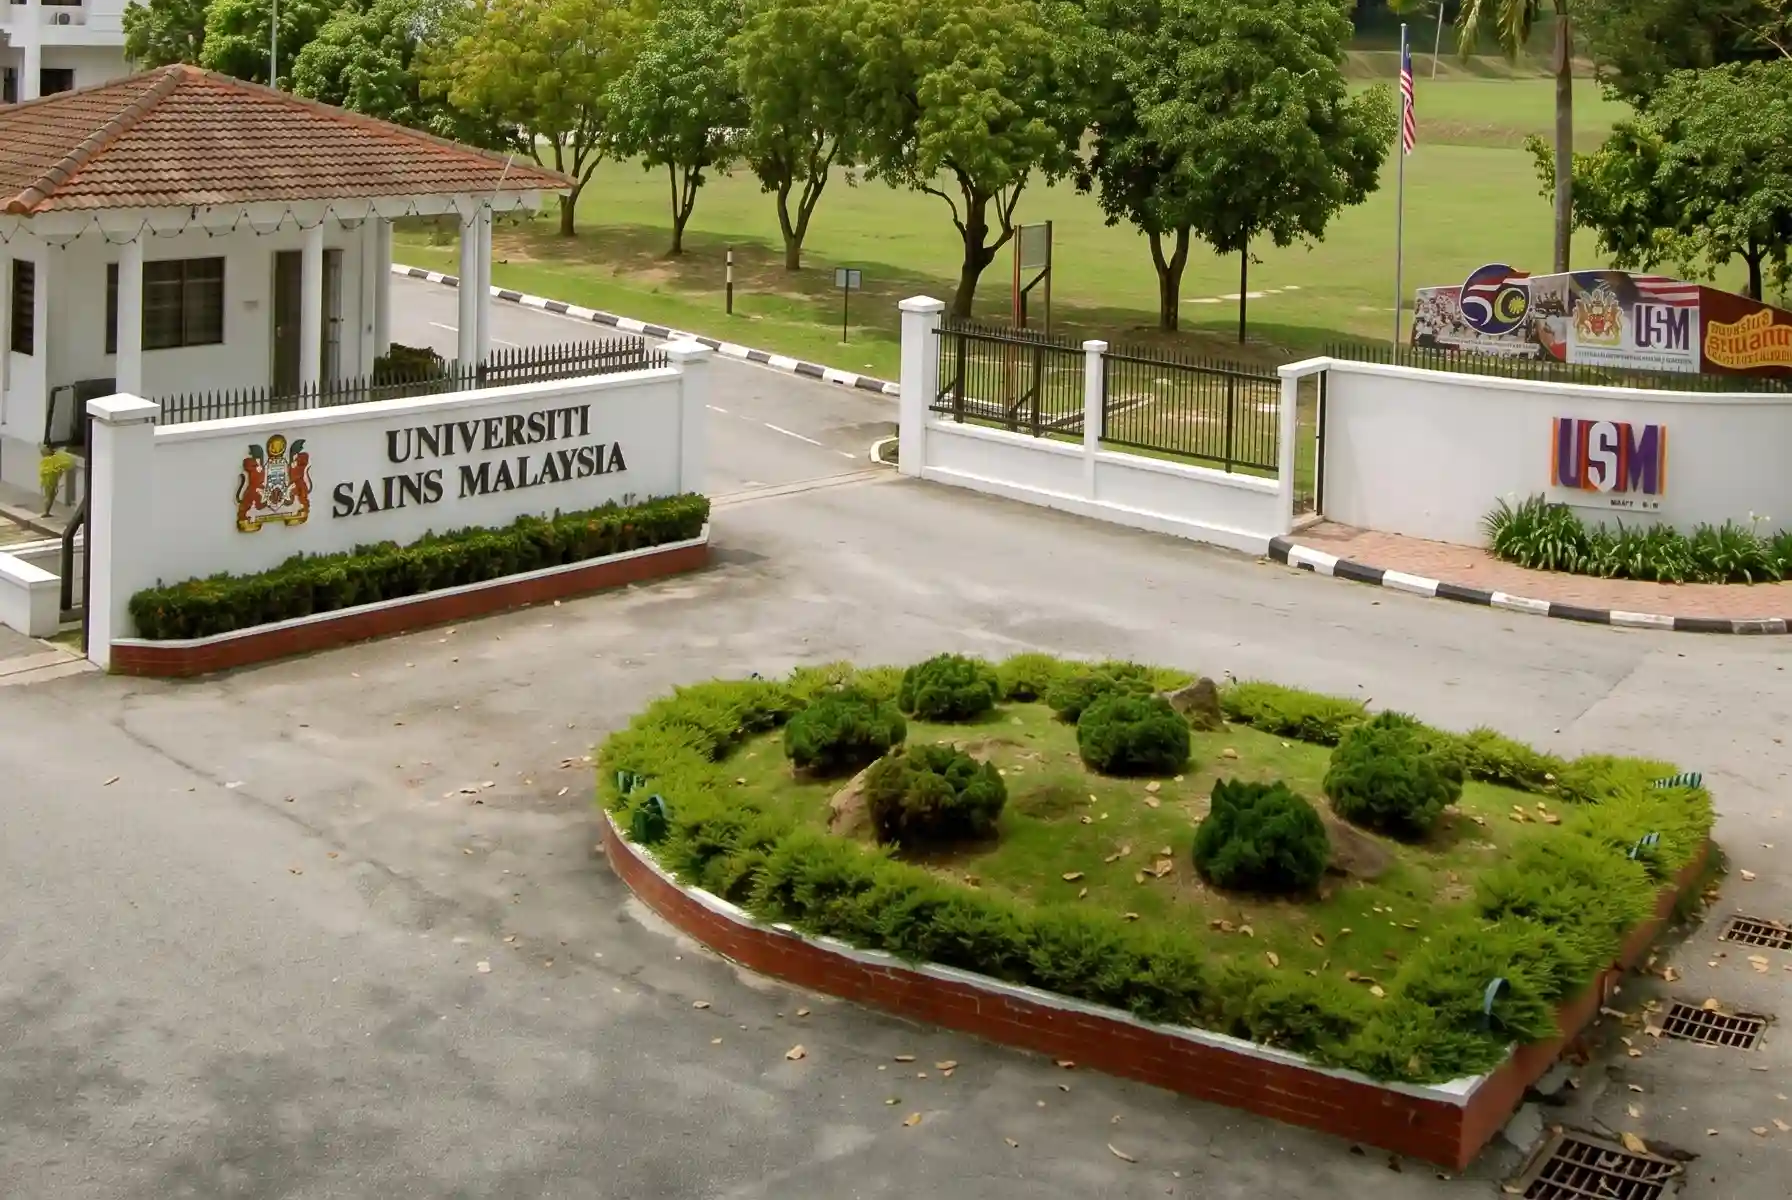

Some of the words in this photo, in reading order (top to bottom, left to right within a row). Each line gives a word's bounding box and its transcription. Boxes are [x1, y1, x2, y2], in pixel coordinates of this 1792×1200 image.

[1461, 278, 1530, 327] 50
[1635, 304, 1690, 351] USM
[385, 404, 592, 464] UNIVERSITI
[1558, 417, 1659, 495] USM
[332, 468, 444, 519] SAINS
[458, 441, 628, 499] MALAYSIA
